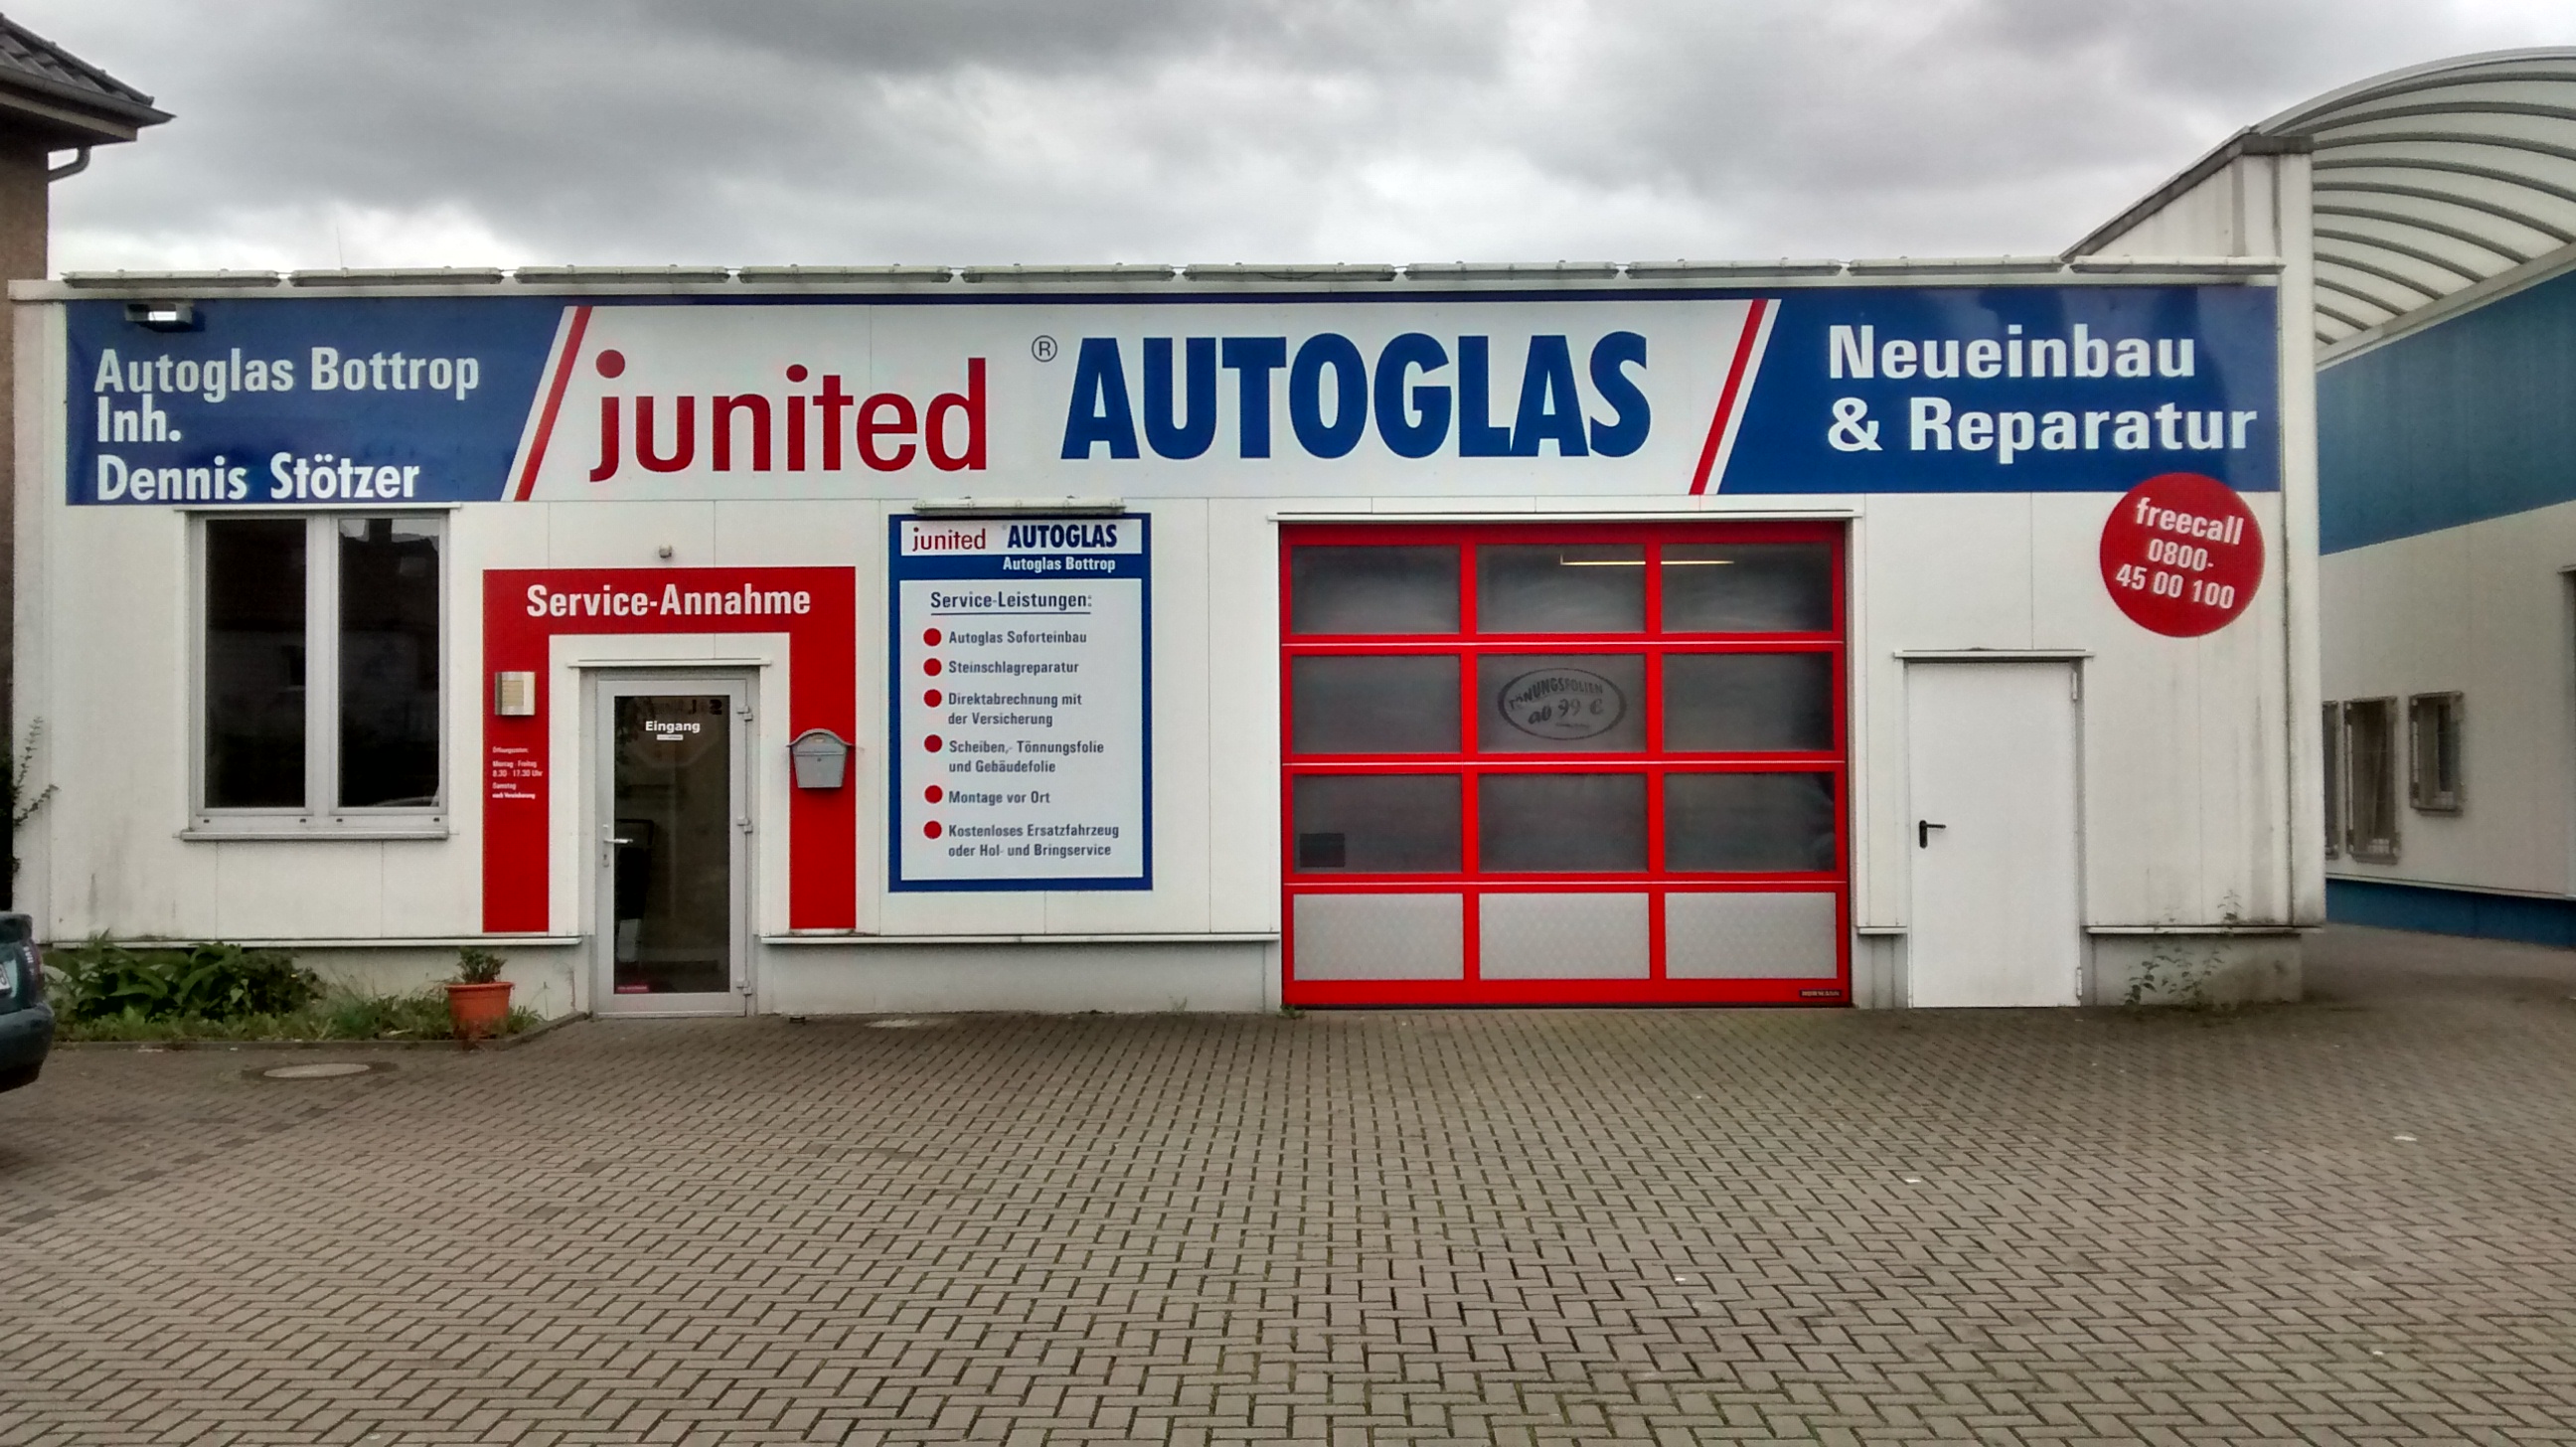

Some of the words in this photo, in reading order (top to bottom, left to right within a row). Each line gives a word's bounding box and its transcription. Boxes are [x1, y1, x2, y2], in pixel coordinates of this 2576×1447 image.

[1829, 323, 2196, 380] Neueinbau
[94, 348, 295, 402] Autoglas
[310, 346, 480, 402] Bottrop
[588, 348, 987, 483] junited
[1059, 330, 1652, 460] AUTOGLAS
[96, 395, 182, 443] Inh.
[1827, 397, 1883, 452] &
[1909, 396, 2258, 465] Reparatur
[96, 454, 247, 502] Dennis
[269, 451, 420, 500] Stötzer
[2135, 496, 2245, 546] freecall
[911, 526, 987, 553] junited
[1007, 524, 1118, 549] AUTOGLAS
[1002, 556, 1062, 573] Autoglas
[1065, 556, 1116, 573] Bottrop
[2147, 538, 2215, 572] 0800-
[2115, 563, 2148, 591] 45
[2152, 570, 2184, 599] 00
[2192, 578, 2236, 610] 100
[526, 582, 812, 618] Service-Annahme
[930, 590, 1093, 611] Service-Leistungen:
[948, 630, 1004, 646] Autoglas
[1007, 630, 1087, 644] Soforteinbau
[948, 660, 1079, 676] Steinschlagreparatur
[948, 693, 1058, 709] Direktabrechnung
[1061, 693, 1082, 706] mit
[1528, 705, 1553, 725] ab
[1557, 698, 1582, 718] 99
[1589, 698, 1604, 716] €
[645, 721, 701, 733] Eingang
[947, 713, 968, 725] der
[971, 712, 1053, 727] Versicherung
[1017, 739, 1105, 756] Tönnungsfolie
[948, 760, 971, 773] und
[975, 759, 1056, 773] Gebäudefolie
[948, 791, 1003, 806] Montage
[1007, 792, 1027, 804] vor
[1031, 791, 1050, 804] Ort
[948, 824, 1024, 838] Kostenloses
[1027, 824, 1119, 839] Ersatzfahrzeug
[948, 845, 975, 858] oder
[979, 844, 1004, 858] Hol-
[1007, 844, 1031, 857] und
[1034, 844, 1112, 859] Bringservice
